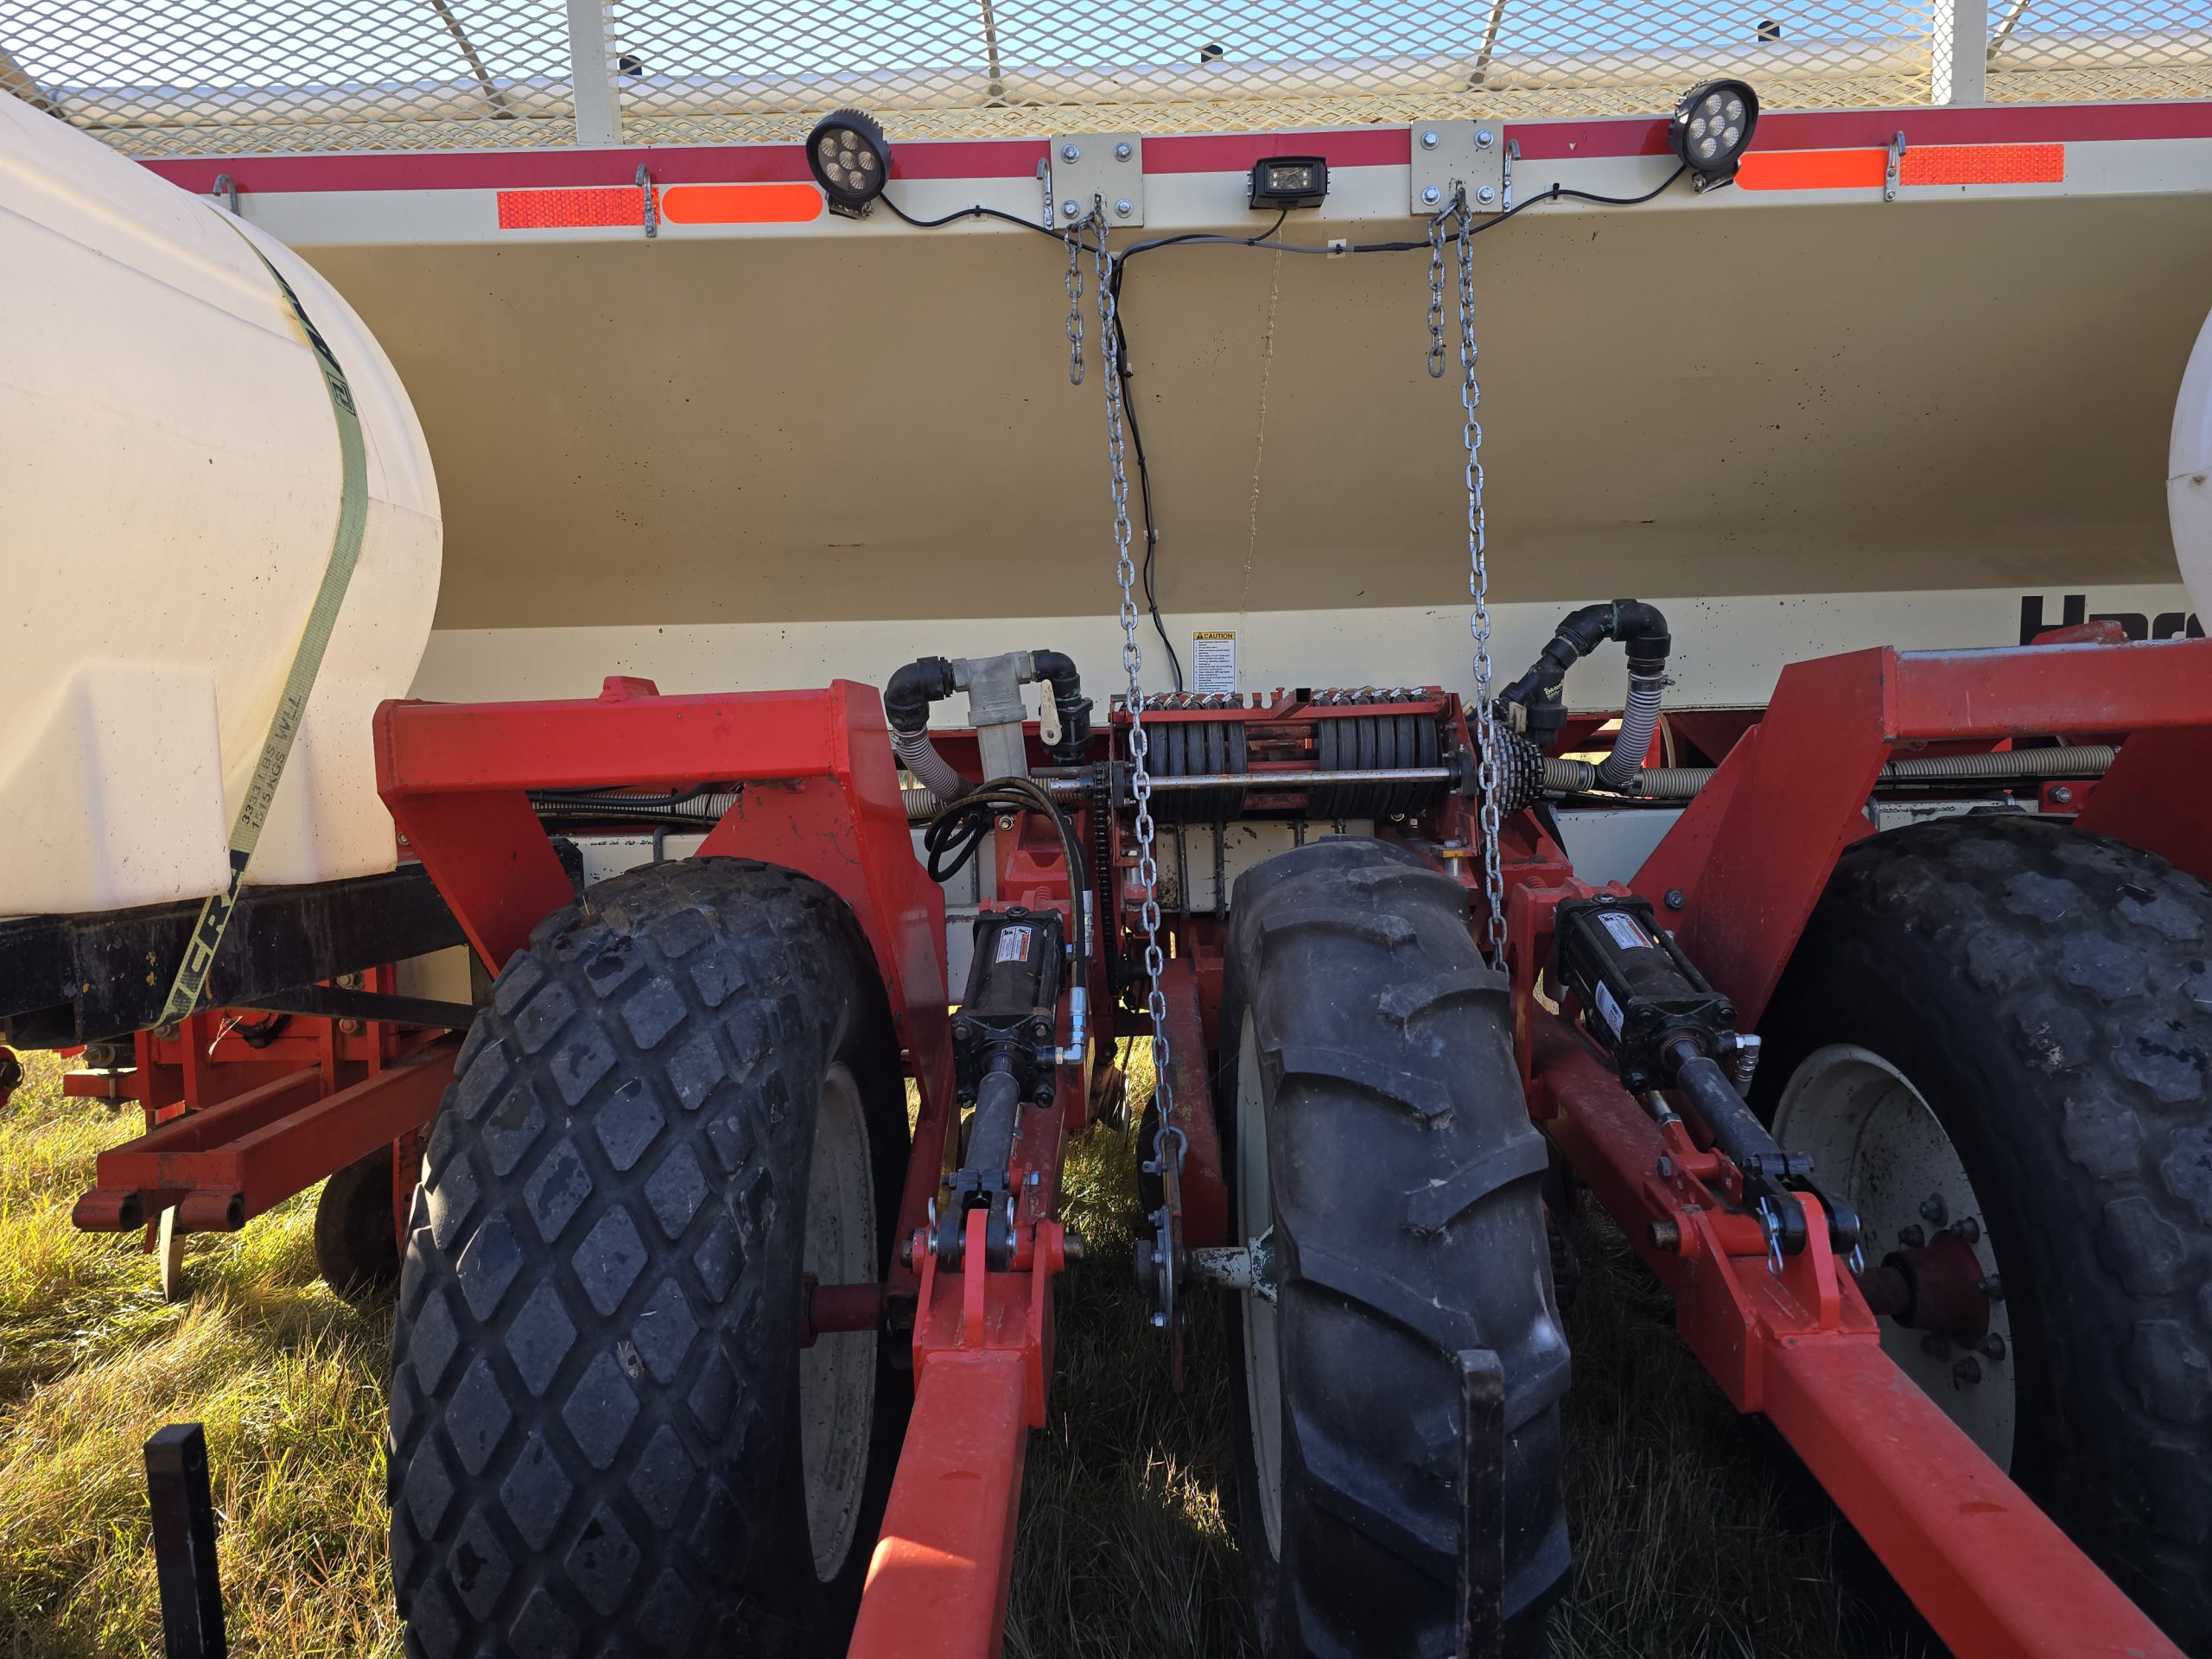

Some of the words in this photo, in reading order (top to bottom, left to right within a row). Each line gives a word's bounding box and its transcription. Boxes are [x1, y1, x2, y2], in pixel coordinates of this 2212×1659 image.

[242, 785, 260, 824] 3333
[257, 745, 275, 781] LBS
[252, 792, 270, 830] 1515
[267, 751, 285, 789] KGS
